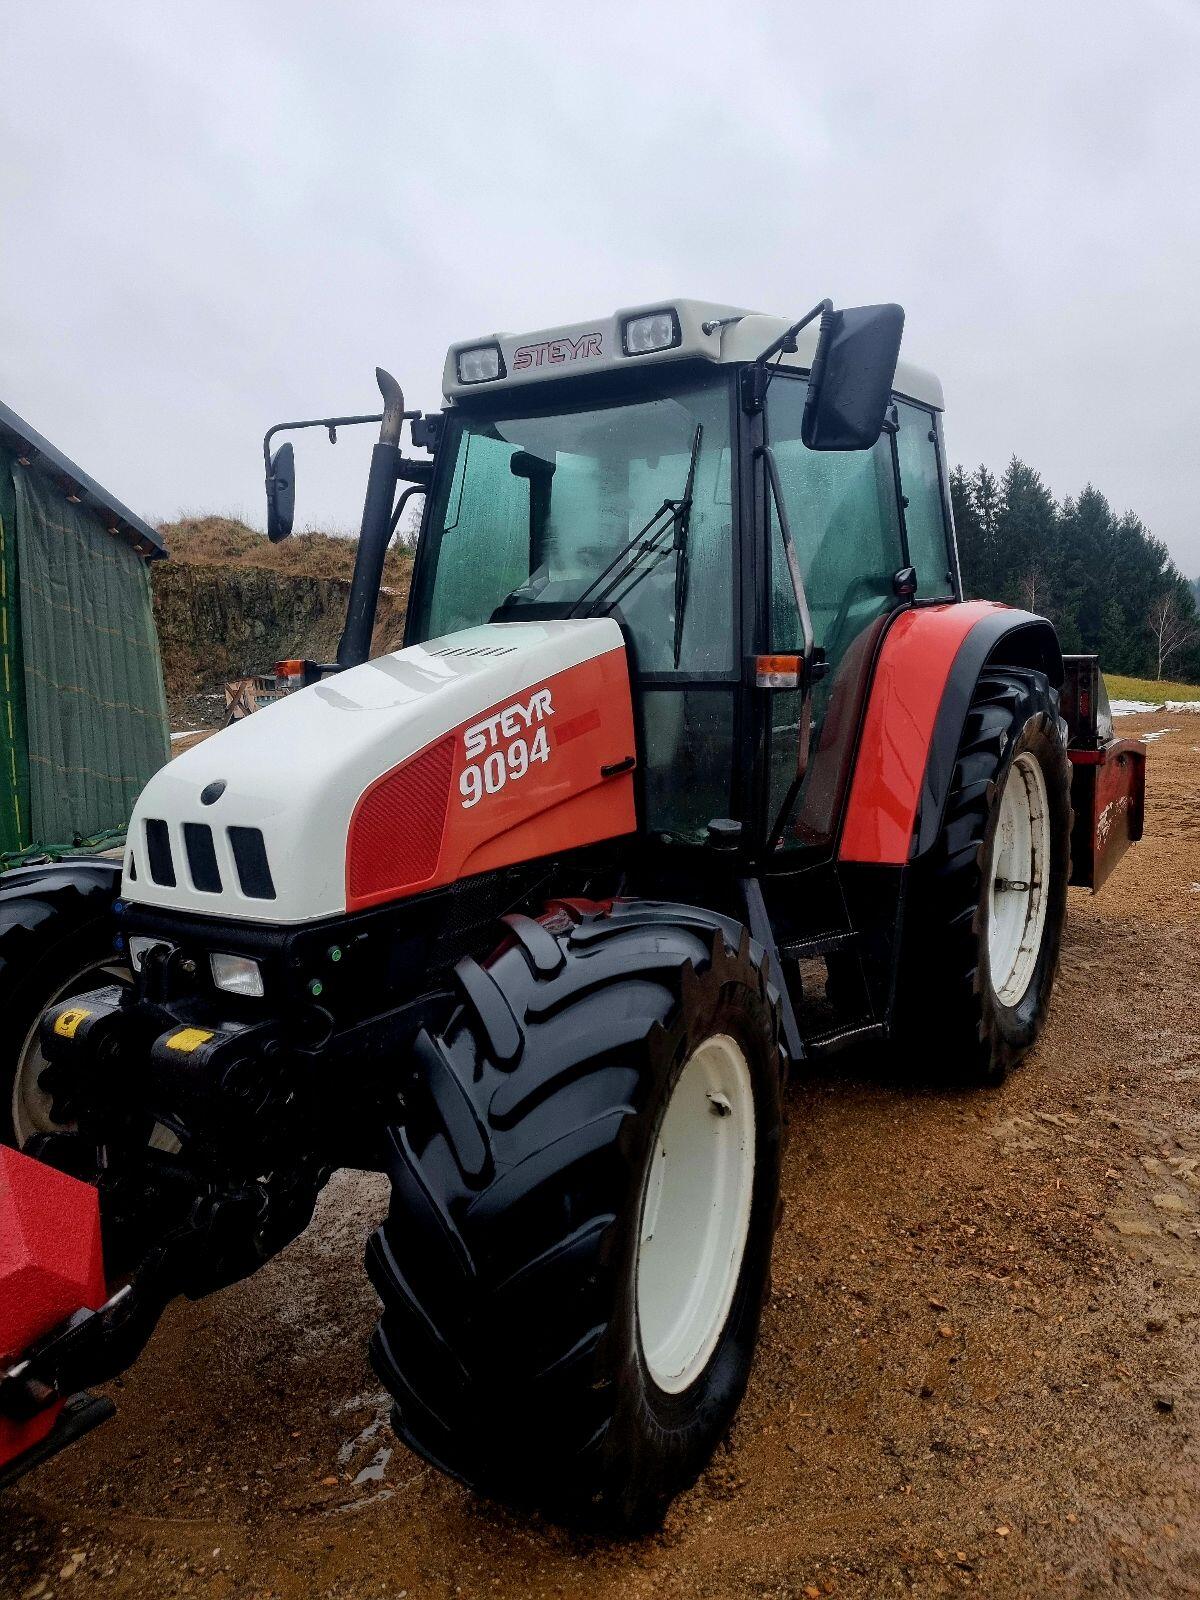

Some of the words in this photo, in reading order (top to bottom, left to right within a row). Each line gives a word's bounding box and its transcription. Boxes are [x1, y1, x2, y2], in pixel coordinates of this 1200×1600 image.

[513, 333, 603, 370] STEYR
[464, 688, 555, 760] STEYR
[459, 726, 551, 809] 9094
